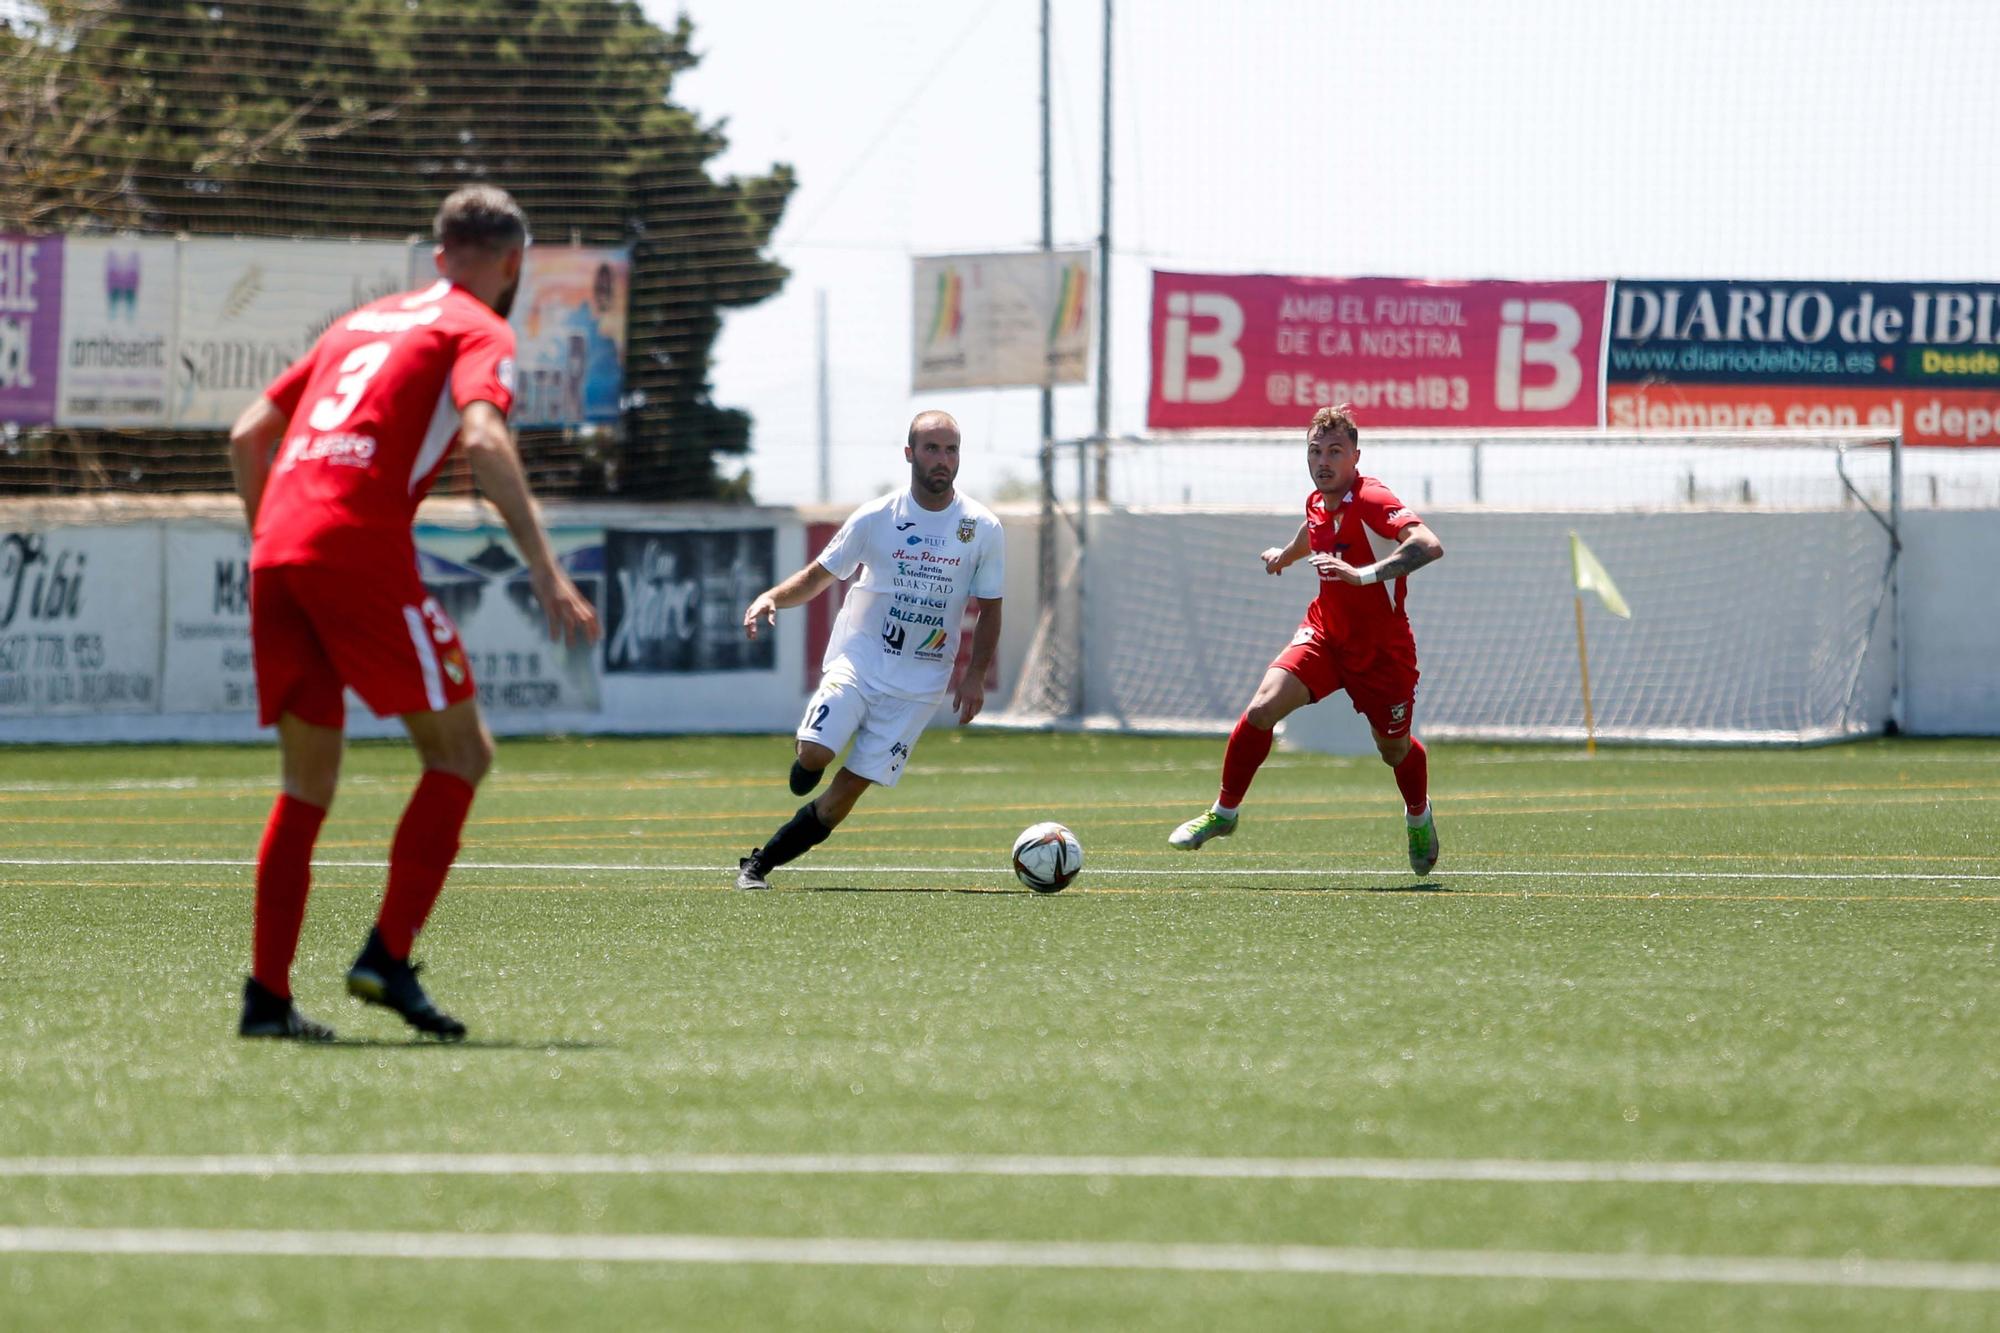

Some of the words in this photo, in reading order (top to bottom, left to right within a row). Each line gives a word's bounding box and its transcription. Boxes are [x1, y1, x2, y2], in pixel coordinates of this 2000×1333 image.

[1279, 295, 1334, 324] AMB
[1338, 297, 1370, 325] EL
[1374, 298, 1468, 327] FUTBOL
[1616, 287, 1835, 343] DIARIO
[1839, 290, 1904, 343] de
[1907, 291, 2000, 344] IBI
[1276, 326, 1311, 355] DE
[1318, 328, 1354, 356] CA
[1359, 329, 1463, 359] NOSTRA
[1613, 346, 1876, 373] www.diariodeibiza.es
[1922, 350, 2000, 374] Desde
[309, 341, 392, 432] 3
[1266, 373, 1469, 412] @EsportsIB3
[1612, 395, 1776, 430] Siempre
[1785, 405, 1859, 429] con
[1867, 400, 1904, 429] el
[1913, 400, 2000, 442] dep
[921, 551, 961, 567] Parrot
[893, 577, 954, 595] BLAKSTAD
[421, 598, 453, 643] 3
[889, 606, 944, 628] BALEARIA
[804, 704, 830, 732] 12
